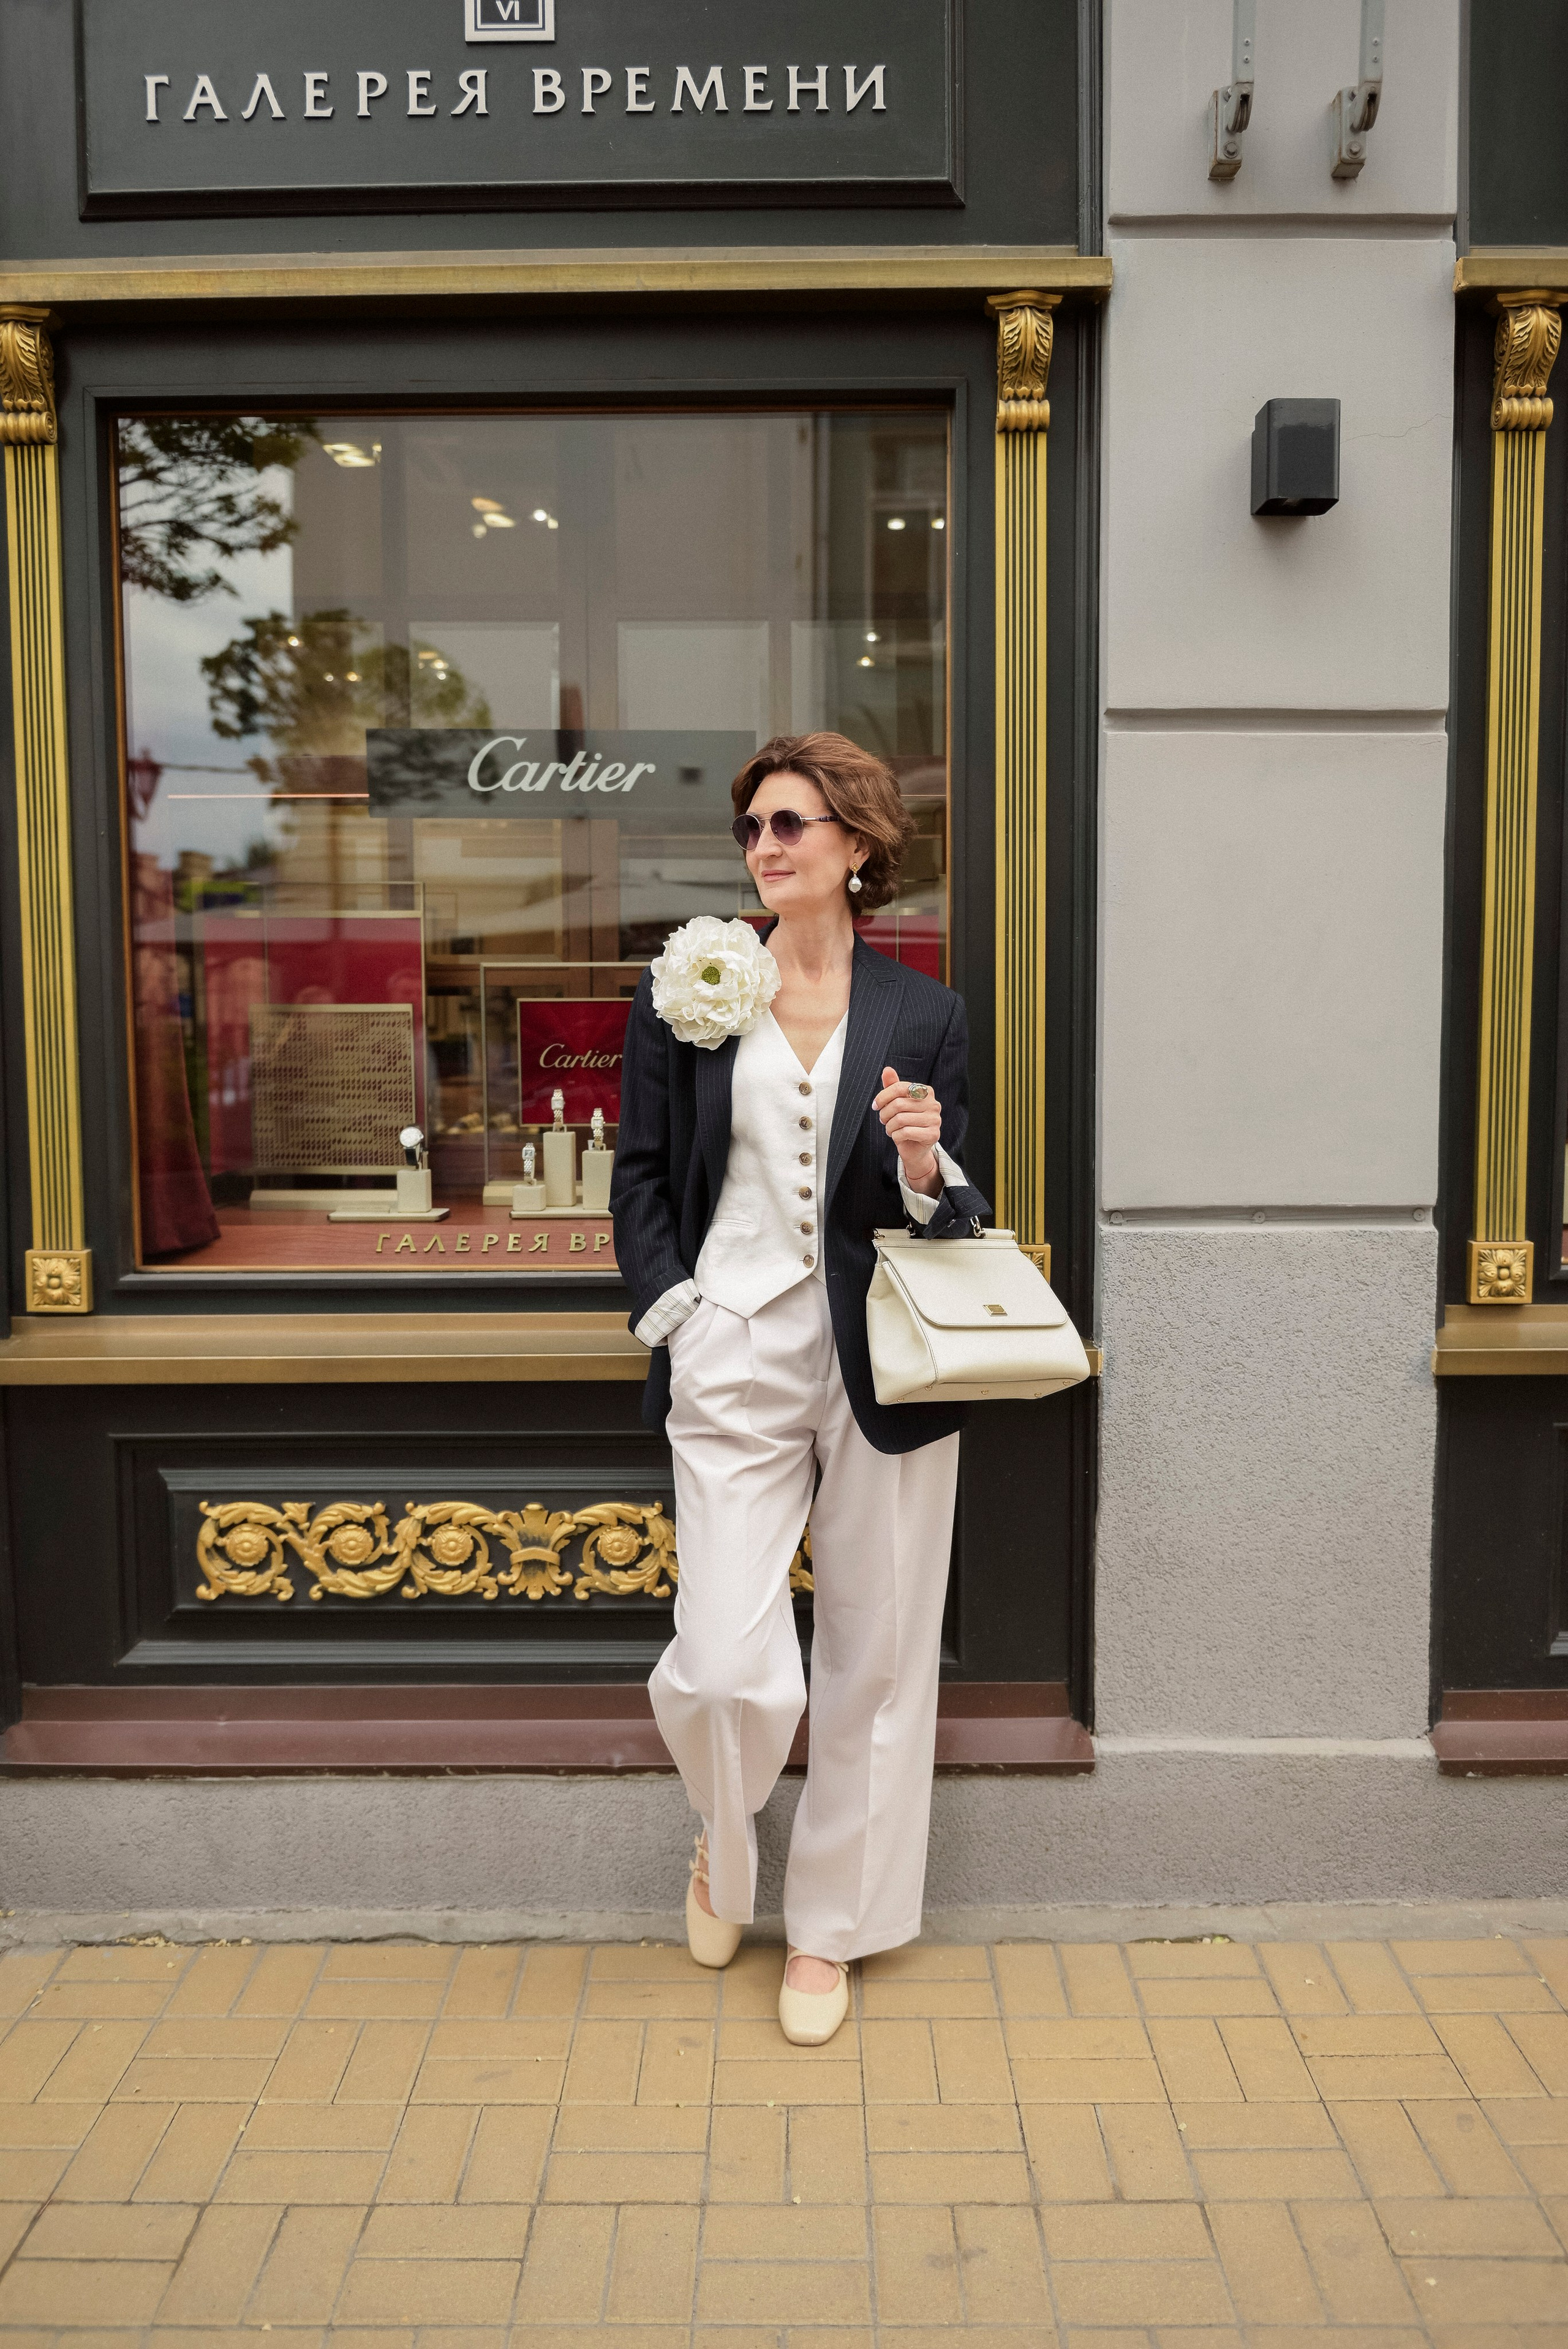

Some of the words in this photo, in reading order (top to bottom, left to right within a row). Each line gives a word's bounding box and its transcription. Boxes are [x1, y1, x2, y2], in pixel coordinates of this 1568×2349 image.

[143, 69, 489, 122] ГАЛЕРЕЯ
[531, 64, 887, 114] ВРЕМЕНИ
[467, 736, 655, 792] Cartier
[539, 1043, 623, 1068] Cartier
[375, 1233, 550, 1253] ГАЛЕРЕЯ
